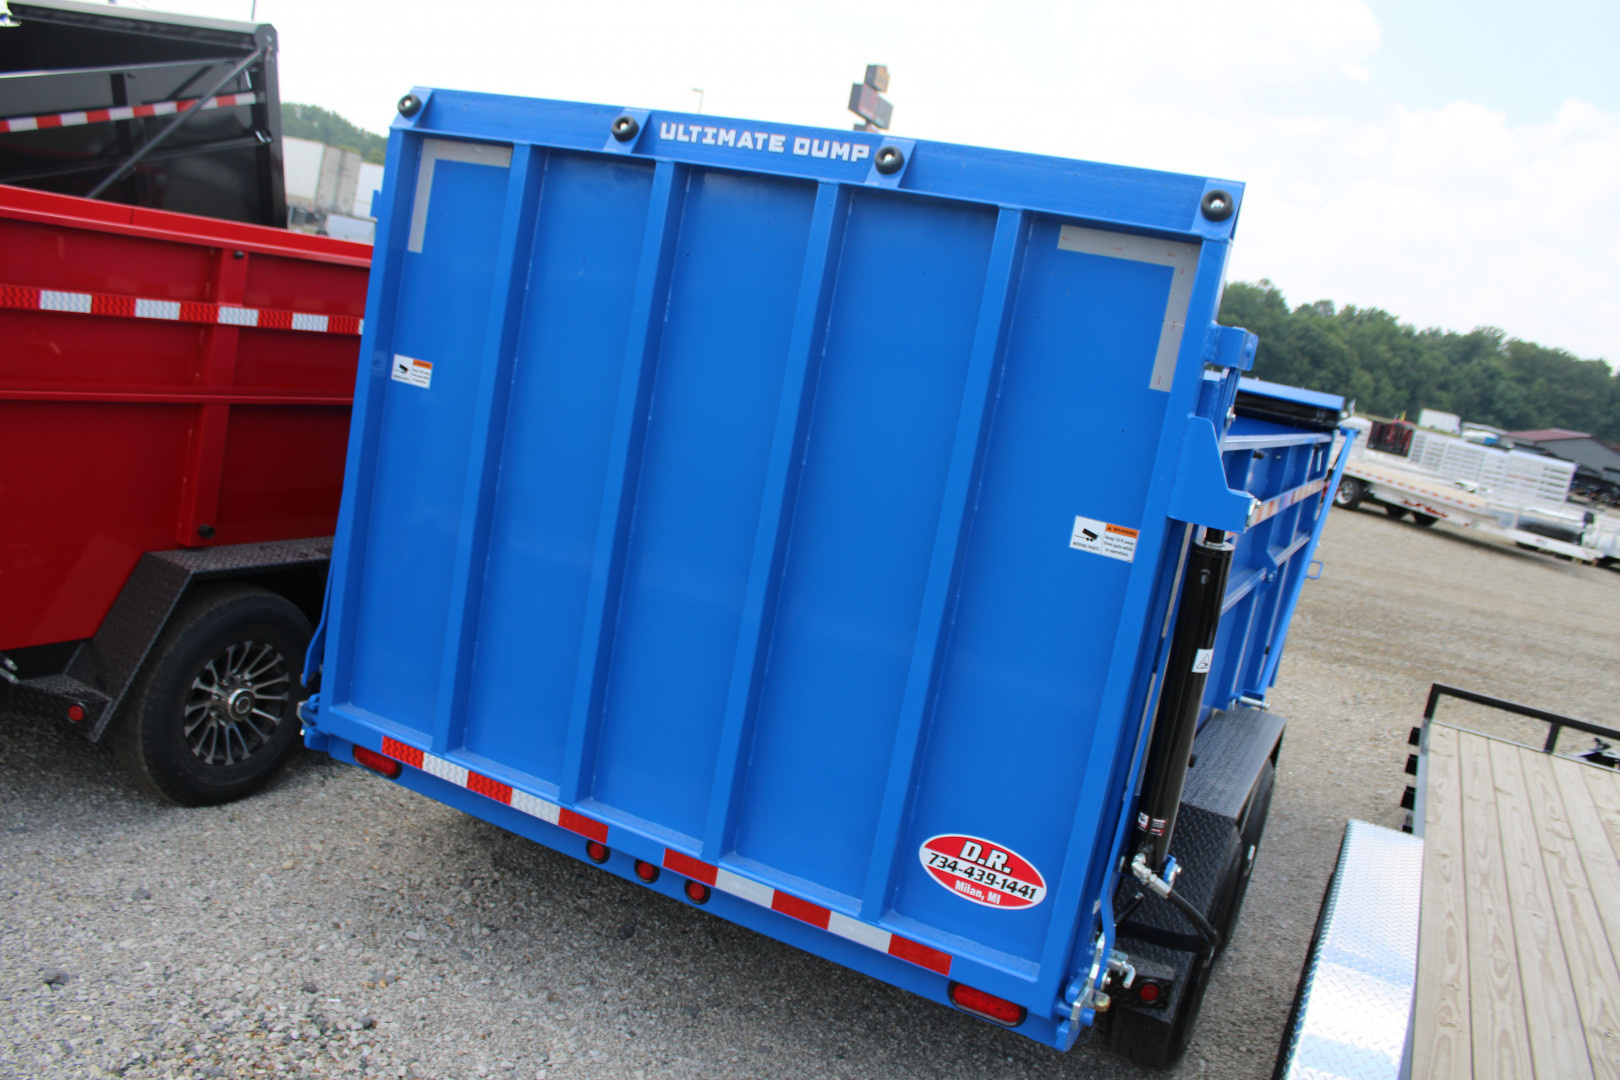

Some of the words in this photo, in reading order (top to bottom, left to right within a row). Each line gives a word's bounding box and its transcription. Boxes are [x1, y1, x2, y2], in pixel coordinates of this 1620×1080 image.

[659, 122, 786, 154] ULTIMATE
[793, 136, 870, 162] DUMP
[1113, 526, 1137, 536] WARNING
[958, 840, 1014, 875] D.R.
[928, 852, 1037, 900] 734-439-1441
[955, 880, 985, 900] Milan,
[987, 891, 1002, 904] MI
